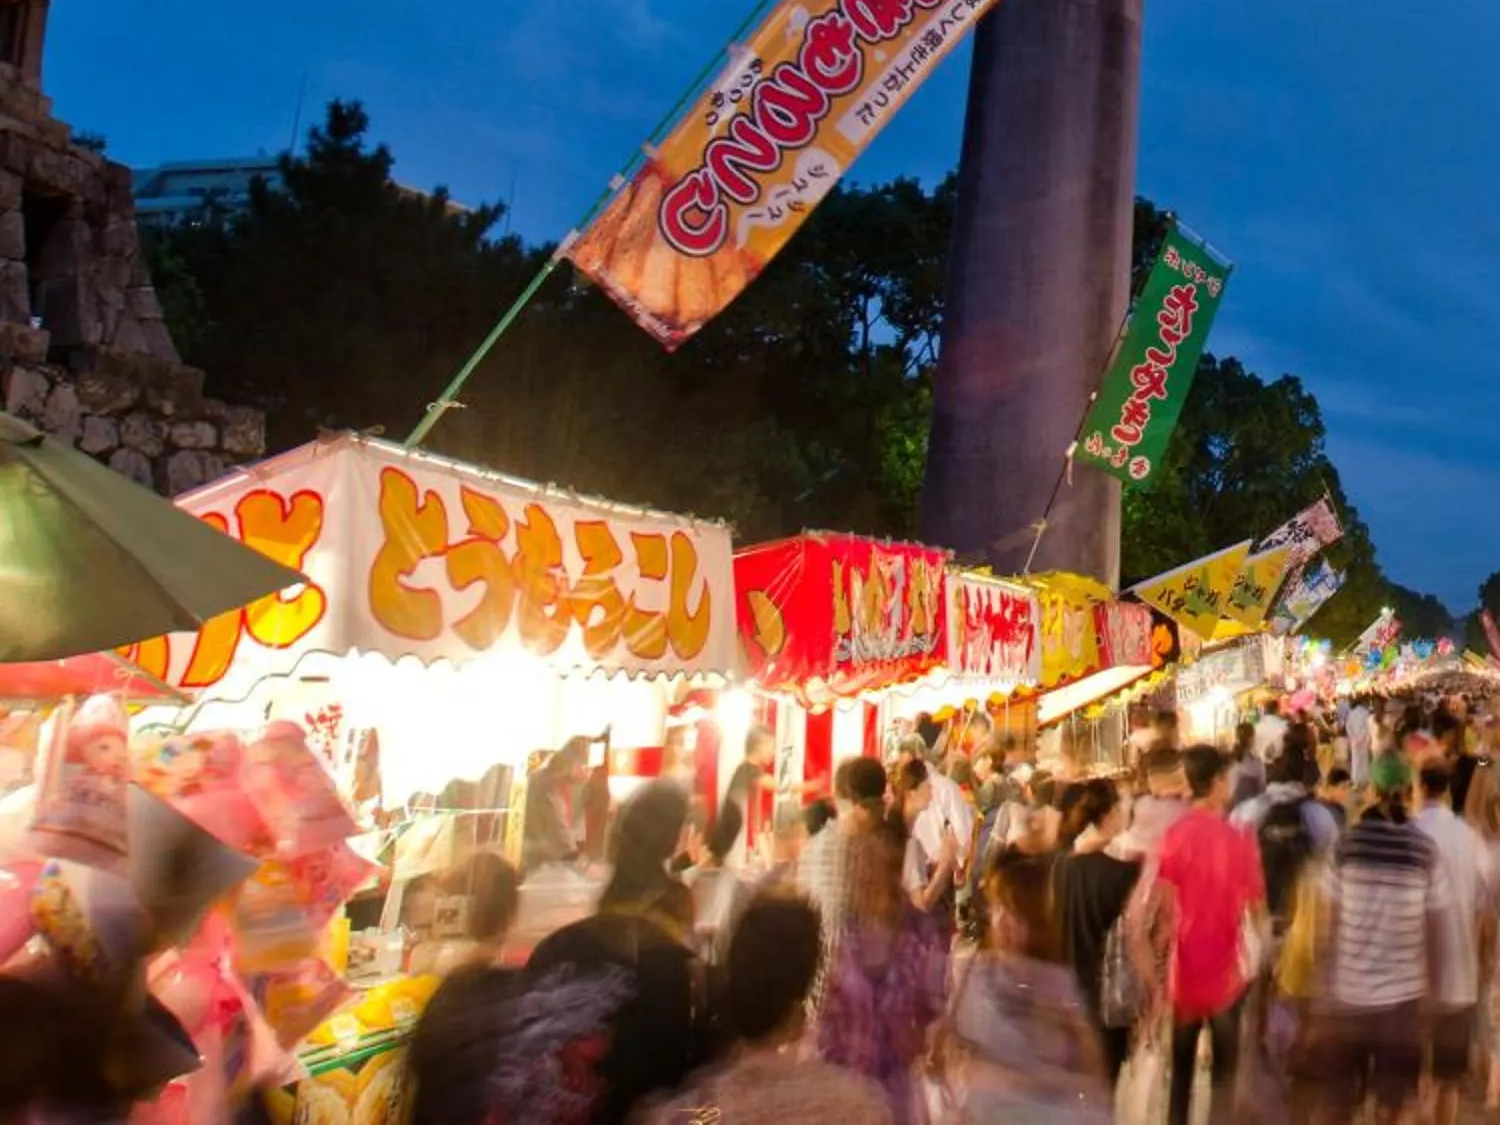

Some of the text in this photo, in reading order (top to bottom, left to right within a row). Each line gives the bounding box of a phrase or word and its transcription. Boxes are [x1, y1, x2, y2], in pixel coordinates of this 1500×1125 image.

[367, 466, 712, 660] とうもろこし
